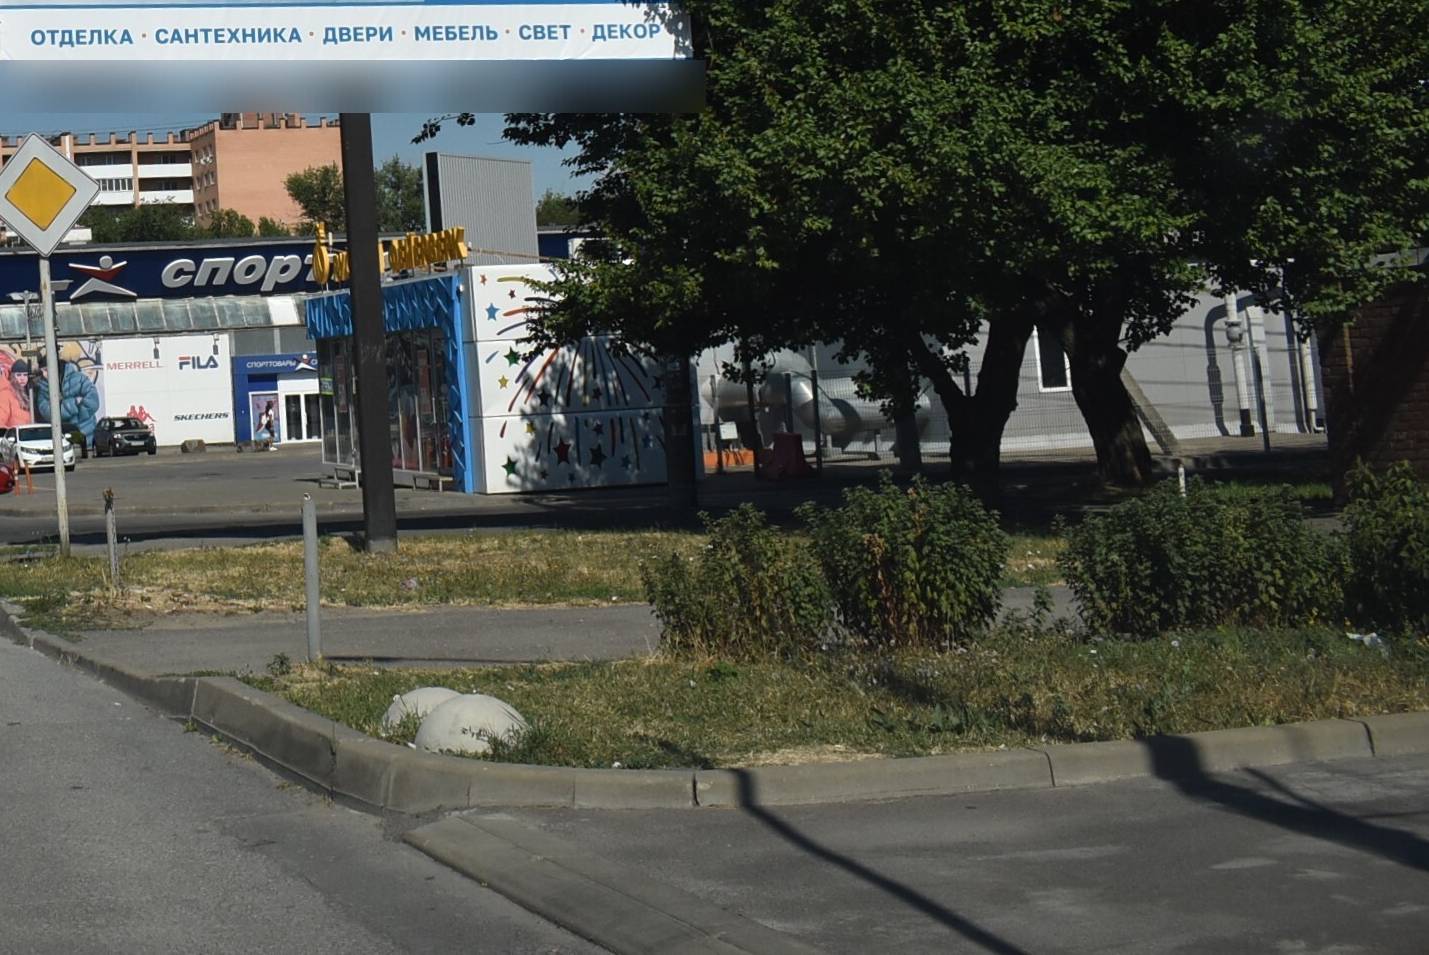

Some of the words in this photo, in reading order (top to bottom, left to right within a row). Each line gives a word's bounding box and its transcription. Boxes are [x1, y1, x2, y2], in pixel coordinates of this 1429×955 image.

[30, 28, 134, 47] ОТДЕЛКА
[154, 27, 302, 45] САНТЕХНИКА
[322, 26, 393, 45] ДВЕРИ
[413, 25, 499, 43] МЕБЕЛЬ
[518, 24, 572, 41] СВЕТ
[591, 23, 661, 42] ДЕКОР
[106, 361, 163, 371] MERRELL
[178, 355, 219, 370] FILA
[246, 360, 296, 369] СПОРТТОВАРЫ
[173, 411, 230, 422] SKECHERS
